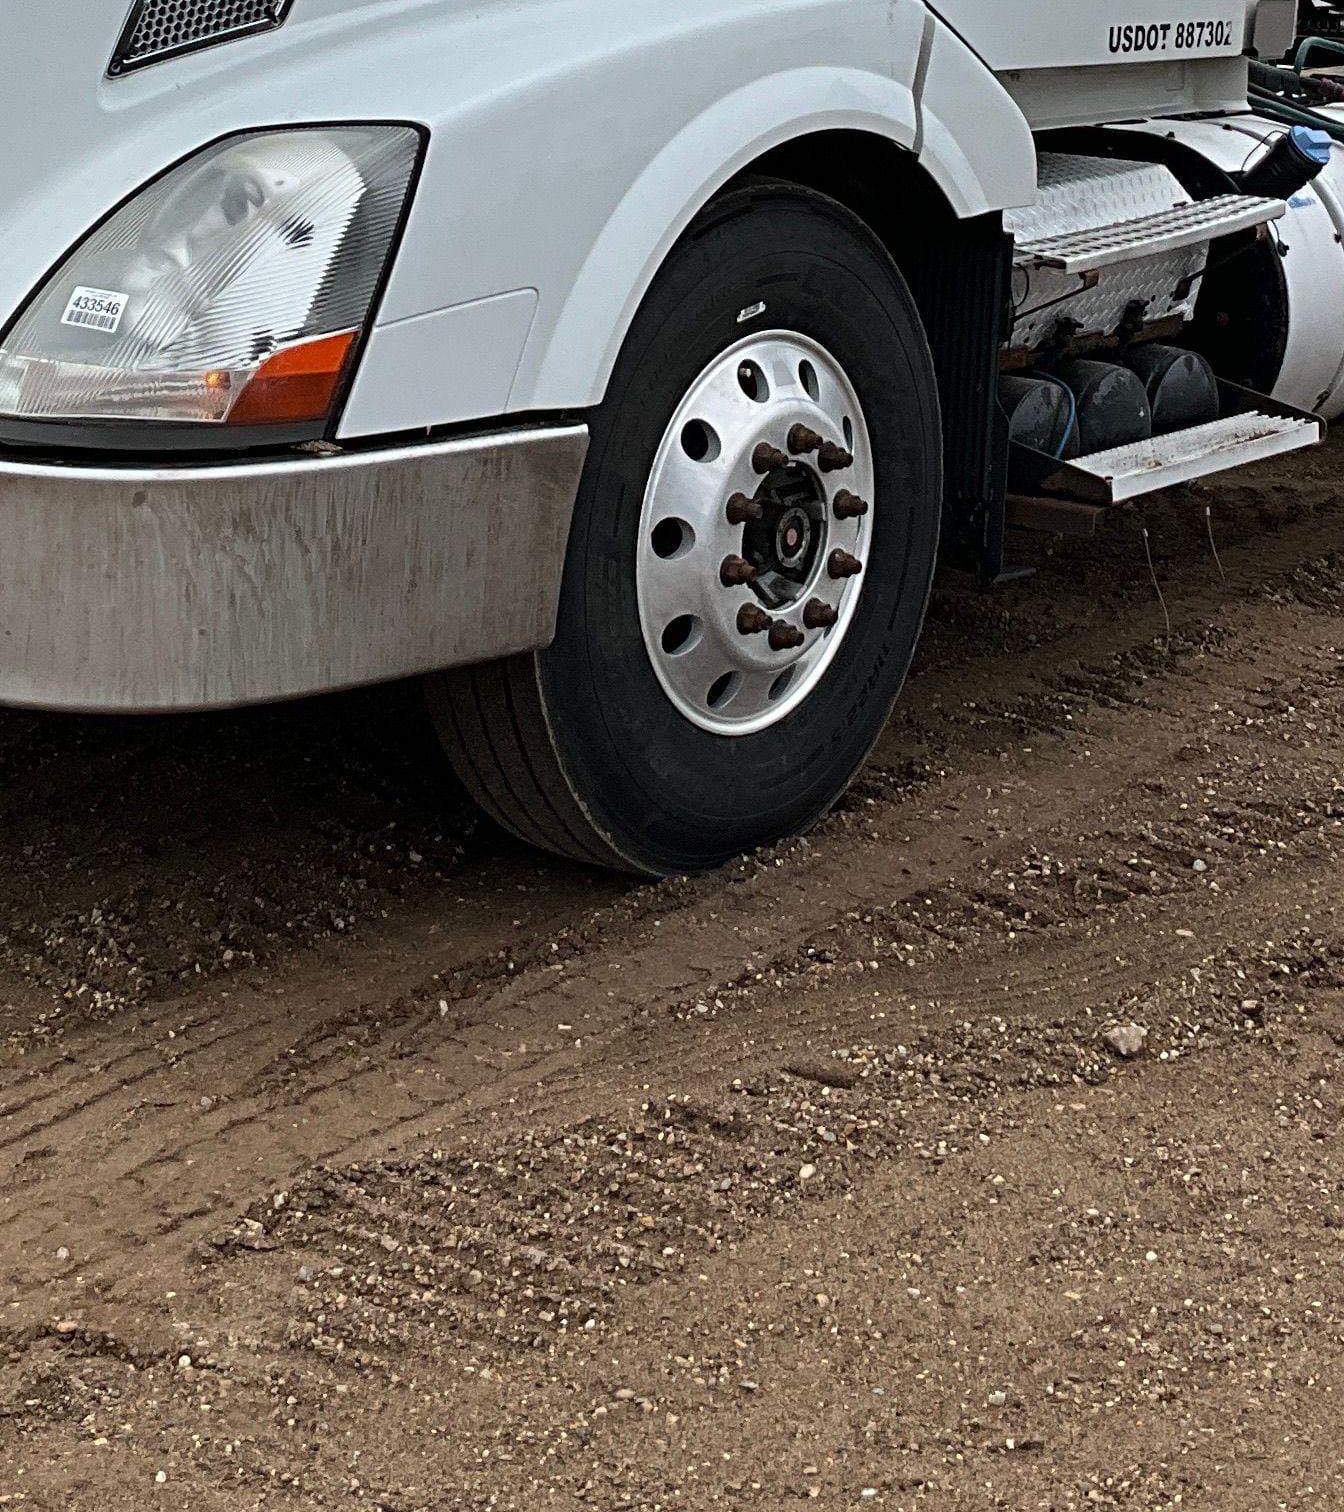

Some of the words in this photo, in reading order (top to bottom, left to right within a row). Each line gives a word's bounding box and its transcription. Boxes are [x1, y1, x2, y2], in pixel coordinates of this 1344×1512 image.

[1109, 23, 1171, 53] USDOT
[1174, 20, 1233, 49] 887302
[72, 295, 121, 316] 433546
